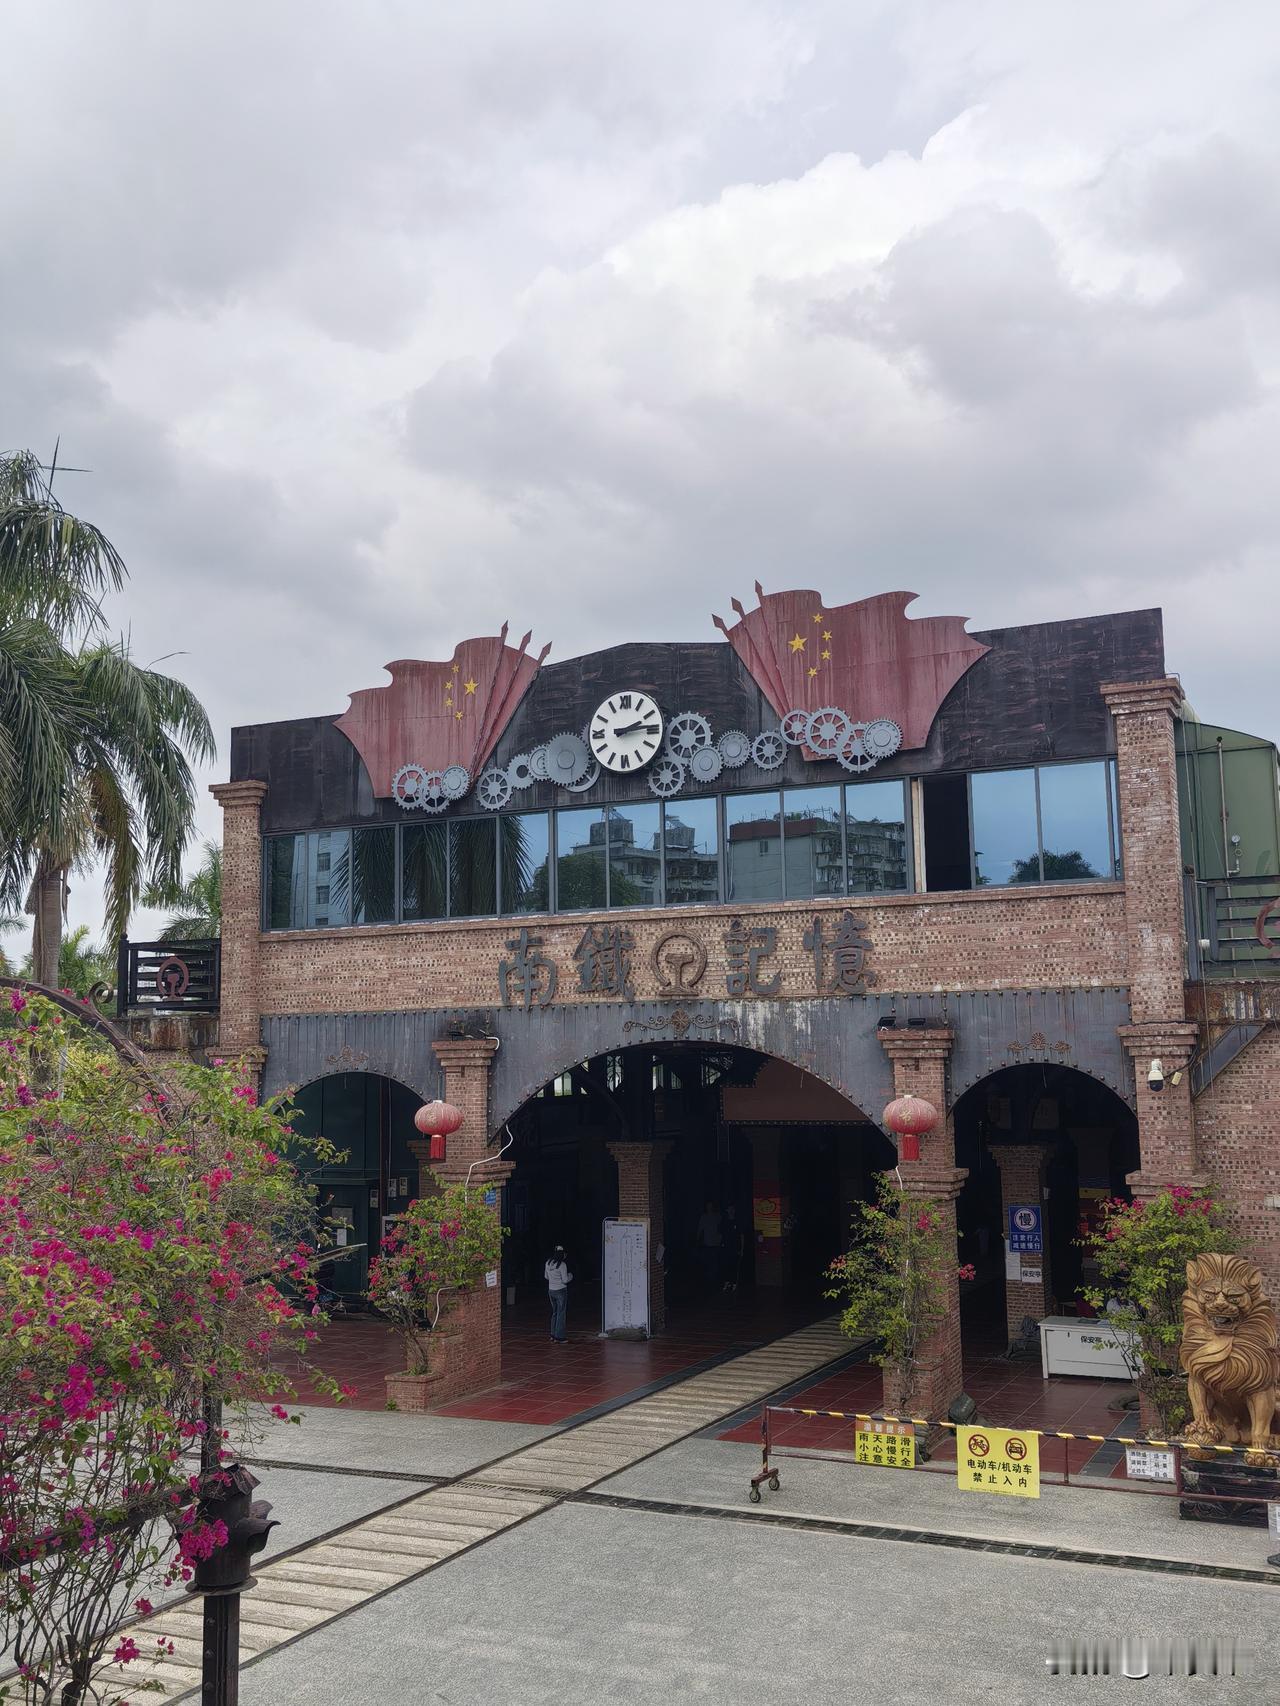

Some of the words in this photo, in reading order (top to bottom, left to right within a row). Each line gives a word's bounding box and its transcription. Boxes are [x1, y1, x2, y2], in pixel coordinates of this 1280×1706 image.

[619, 694, 632, 710] XII
[1018, 1212, 1032, 1227] 慢
[863, 1422, 906, 1434] 温馨提示
[859, 1432, 911, 1447] 雨天路滑
[859, 1443, 911, 1457] 小心慢行
[859, 1453, 911, 1467] 注意安全
[967, 1458, 1032, 1474] 电动车/机动车
[973, 1472, 1028, 1488] 禁止入内
